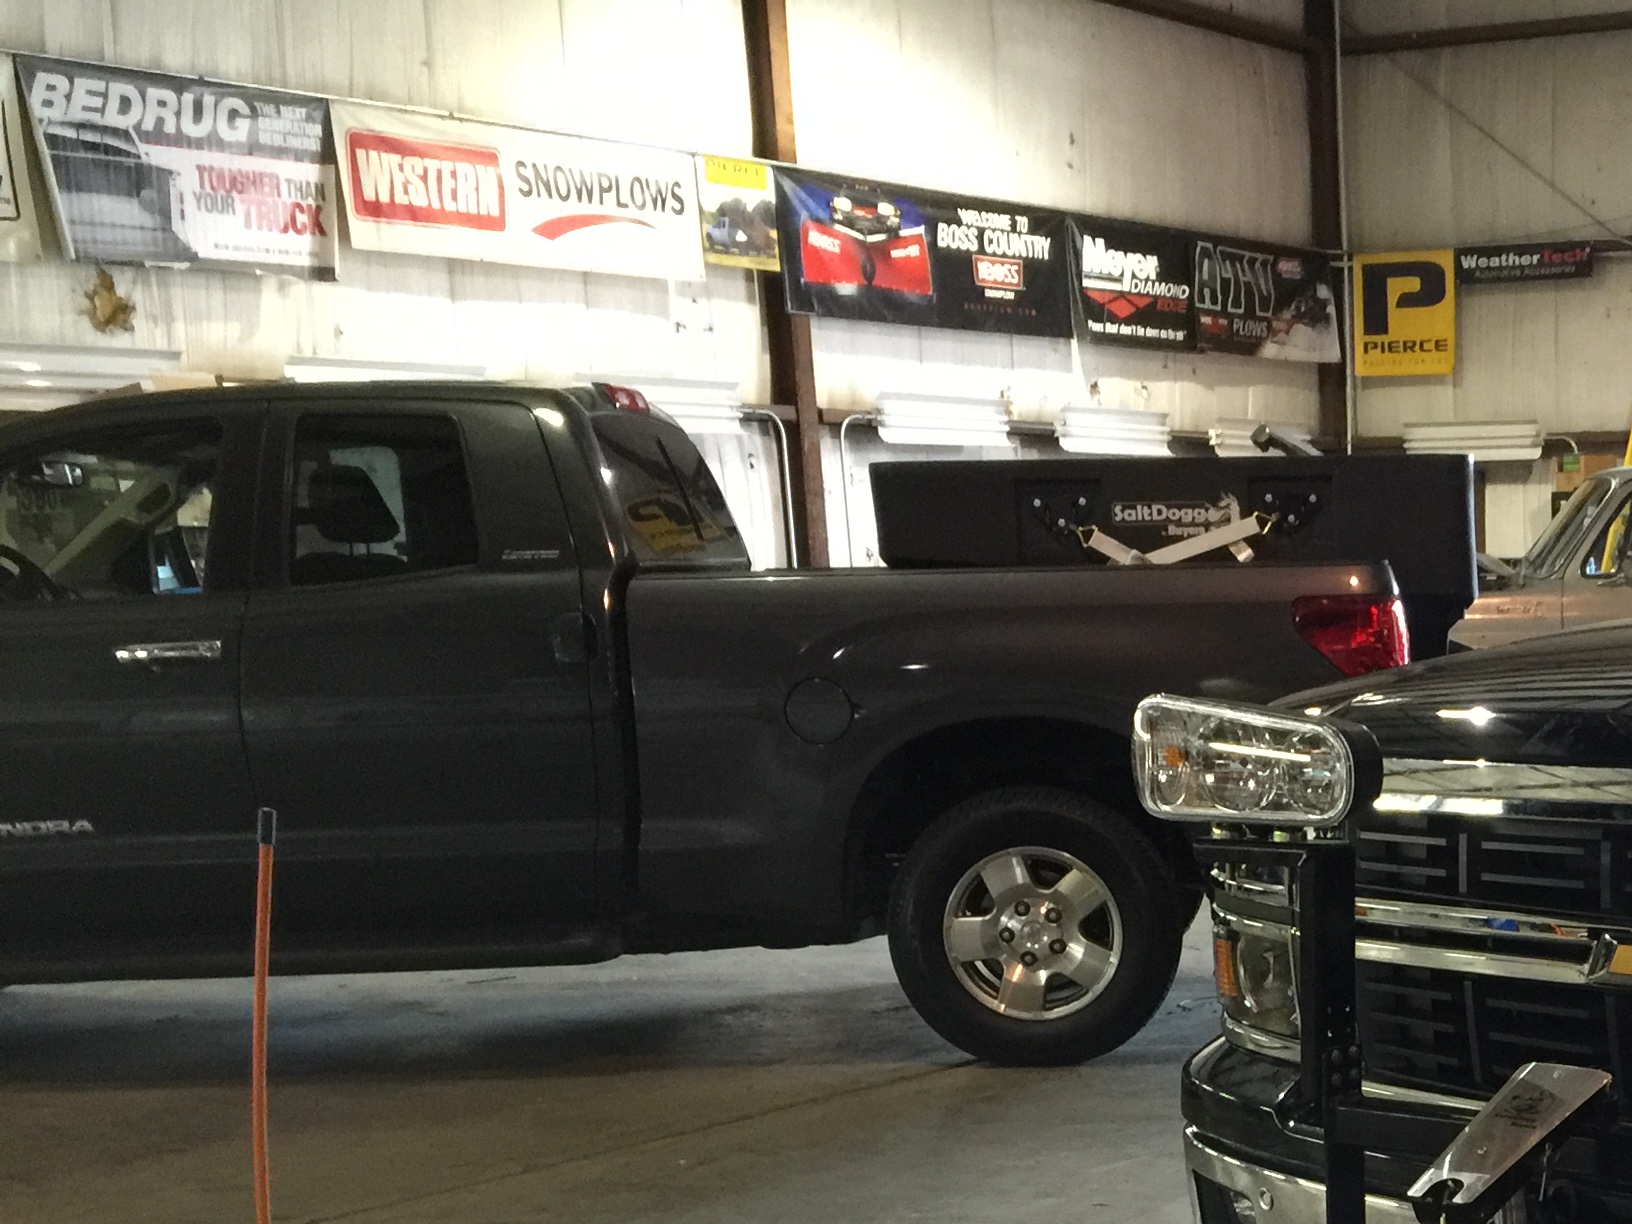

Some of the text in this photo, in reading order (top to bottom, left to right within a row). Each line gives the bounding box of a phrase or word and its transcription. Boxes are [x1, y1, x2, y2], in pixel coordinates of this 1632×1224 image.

[30, 72, 251, 142] BEDRUG
[195, 164, 326, 202] TOUGHER THAN
[355, 148, 685, 217] WESTERN SNOWPLOWS
[193, 190, 327, 237] YOUR TRUCK
[957, 208, 1028, 233] WELCOME TO
[937, 222, 1050, 259] BOSS COUNTRY
[1082, 234, 1160, 292] Meyer
[1131, 279, 1190, 299] DIAMOND
[1233, 318, 1268, 338] PLOWS
[1363, 338, 1448, 355] PIERCE
[1114, 504, 1209, 522] SaltDogg
